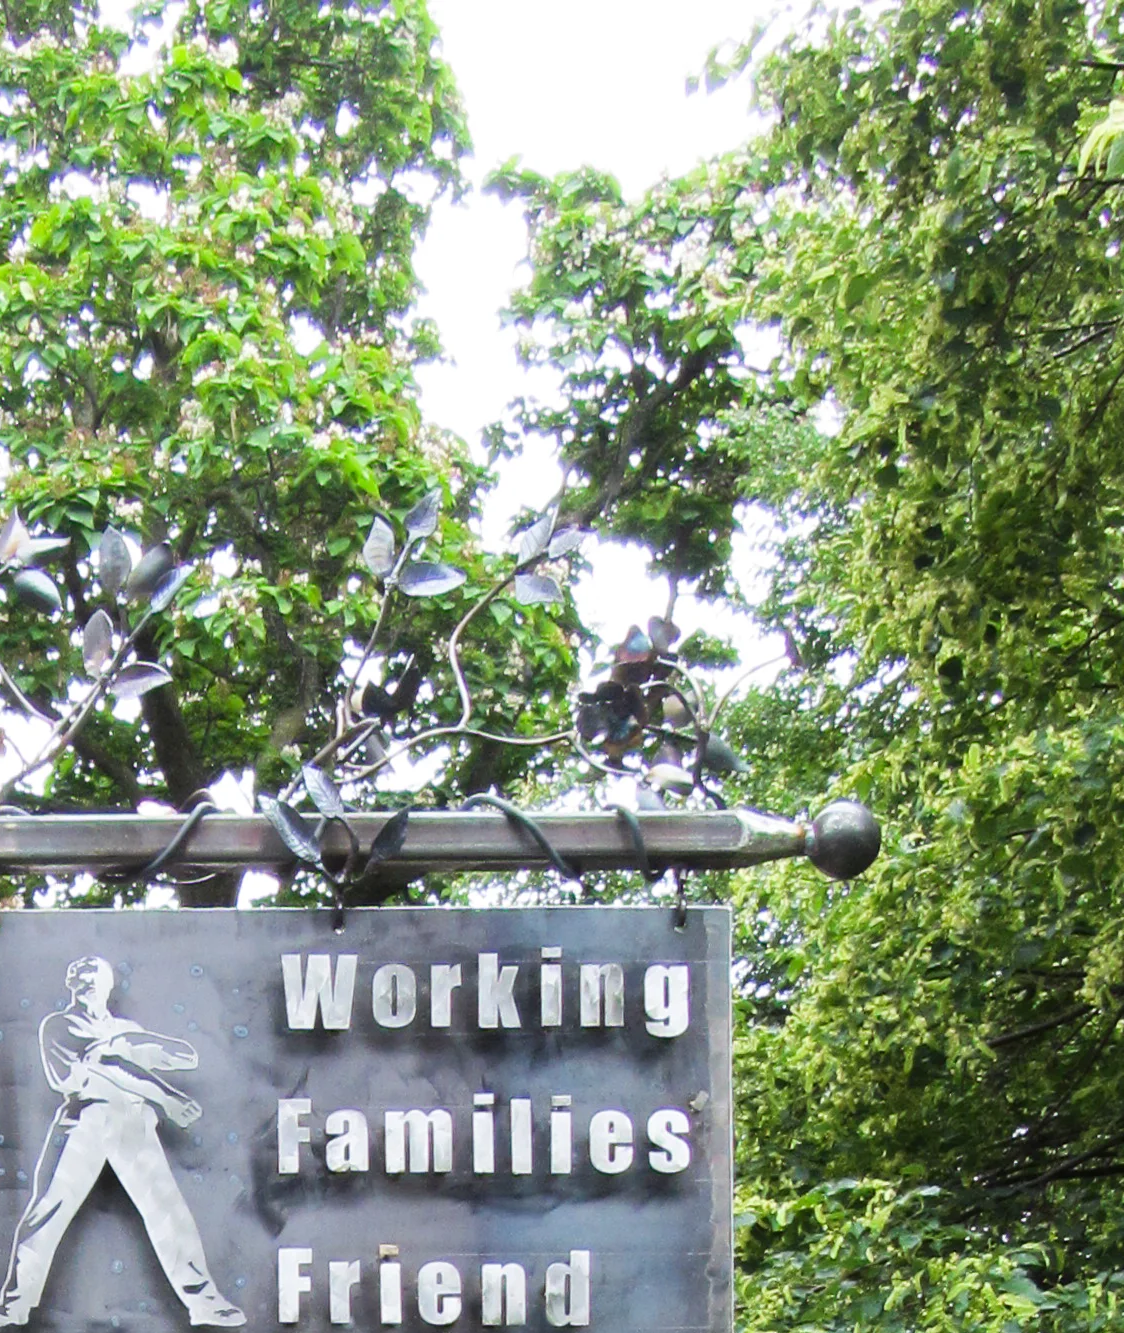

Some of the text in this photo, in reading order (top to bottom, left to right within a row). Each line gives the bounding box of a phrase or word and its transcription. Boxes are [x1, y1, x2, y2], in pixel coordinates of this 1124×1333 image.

[280, 946, 691, 1038] Working
[277, 1092, 692, 1175] Families
[277, 1244, 591, 1327] Friend
